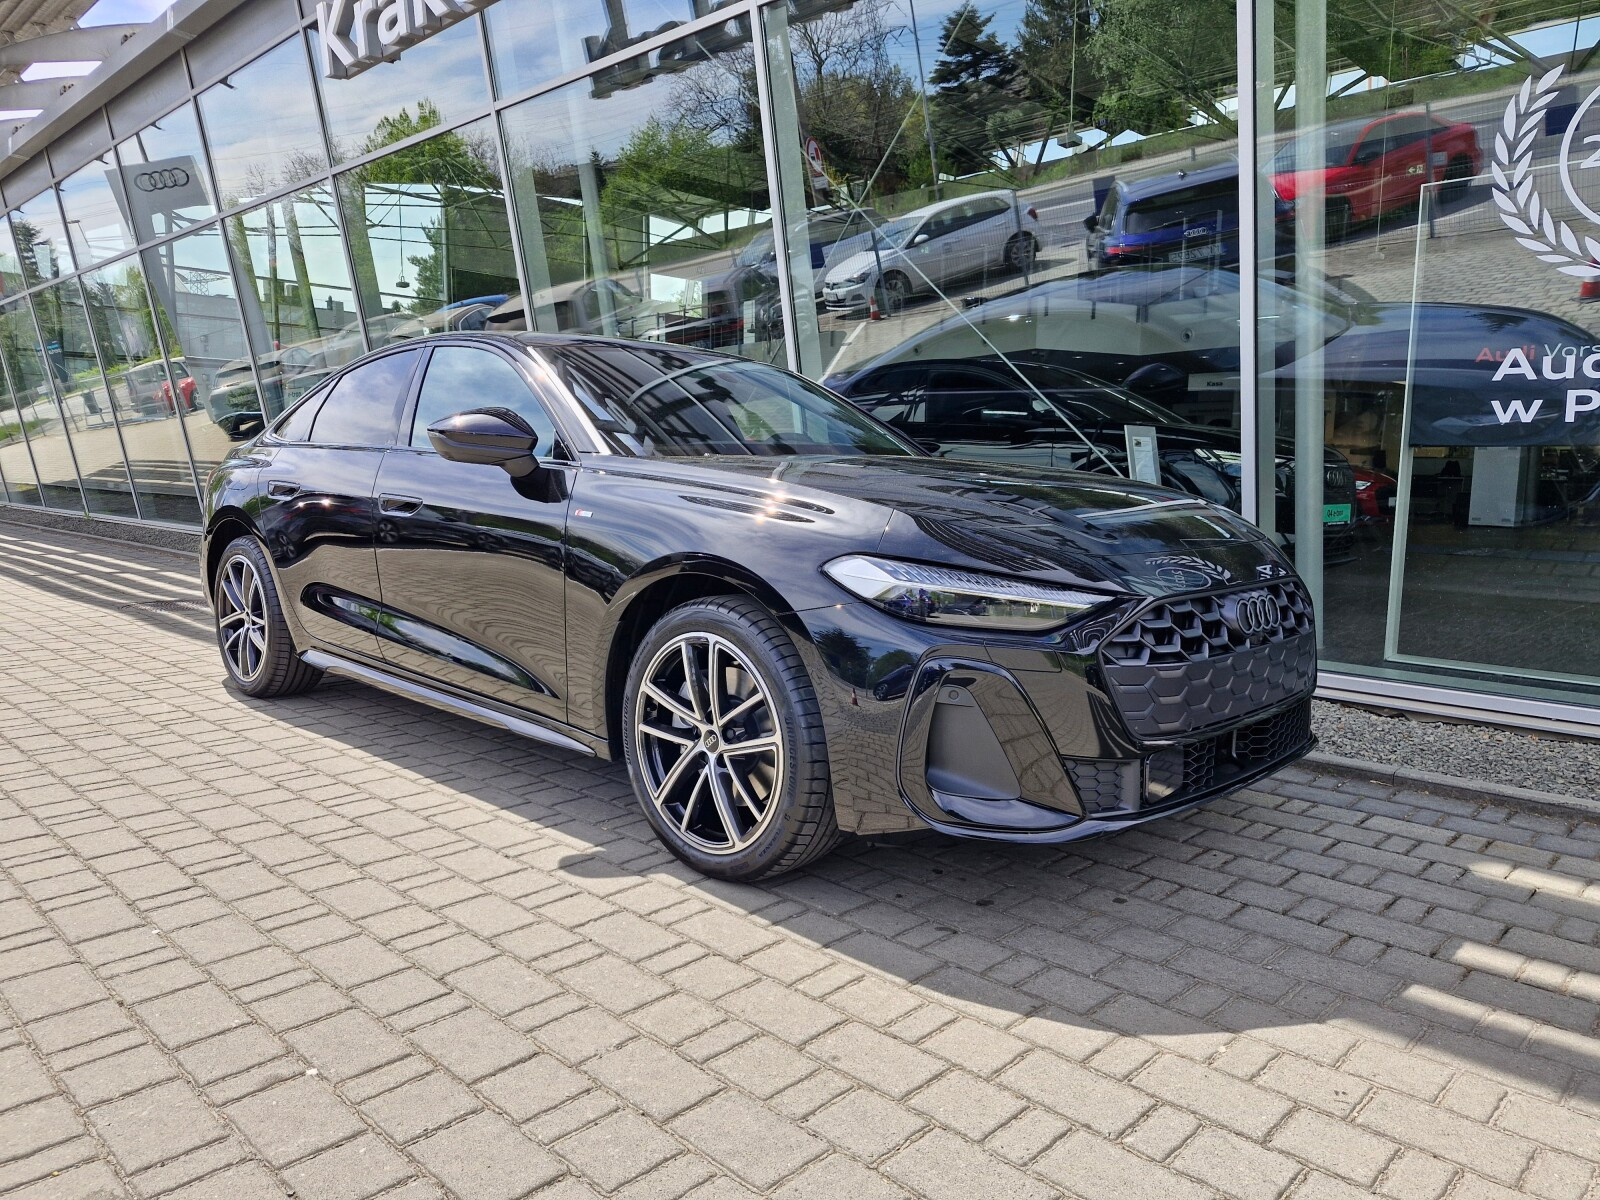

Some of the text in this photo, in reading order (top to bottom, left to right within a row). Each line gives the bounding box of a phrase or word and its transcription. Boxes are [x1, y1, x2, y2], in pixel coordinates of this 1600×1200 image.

[1474, 344, 1536, 363] Aui
[1490, 399, 1544, 424] w
[784, 716, 799, 799] BRIDGESTONE
